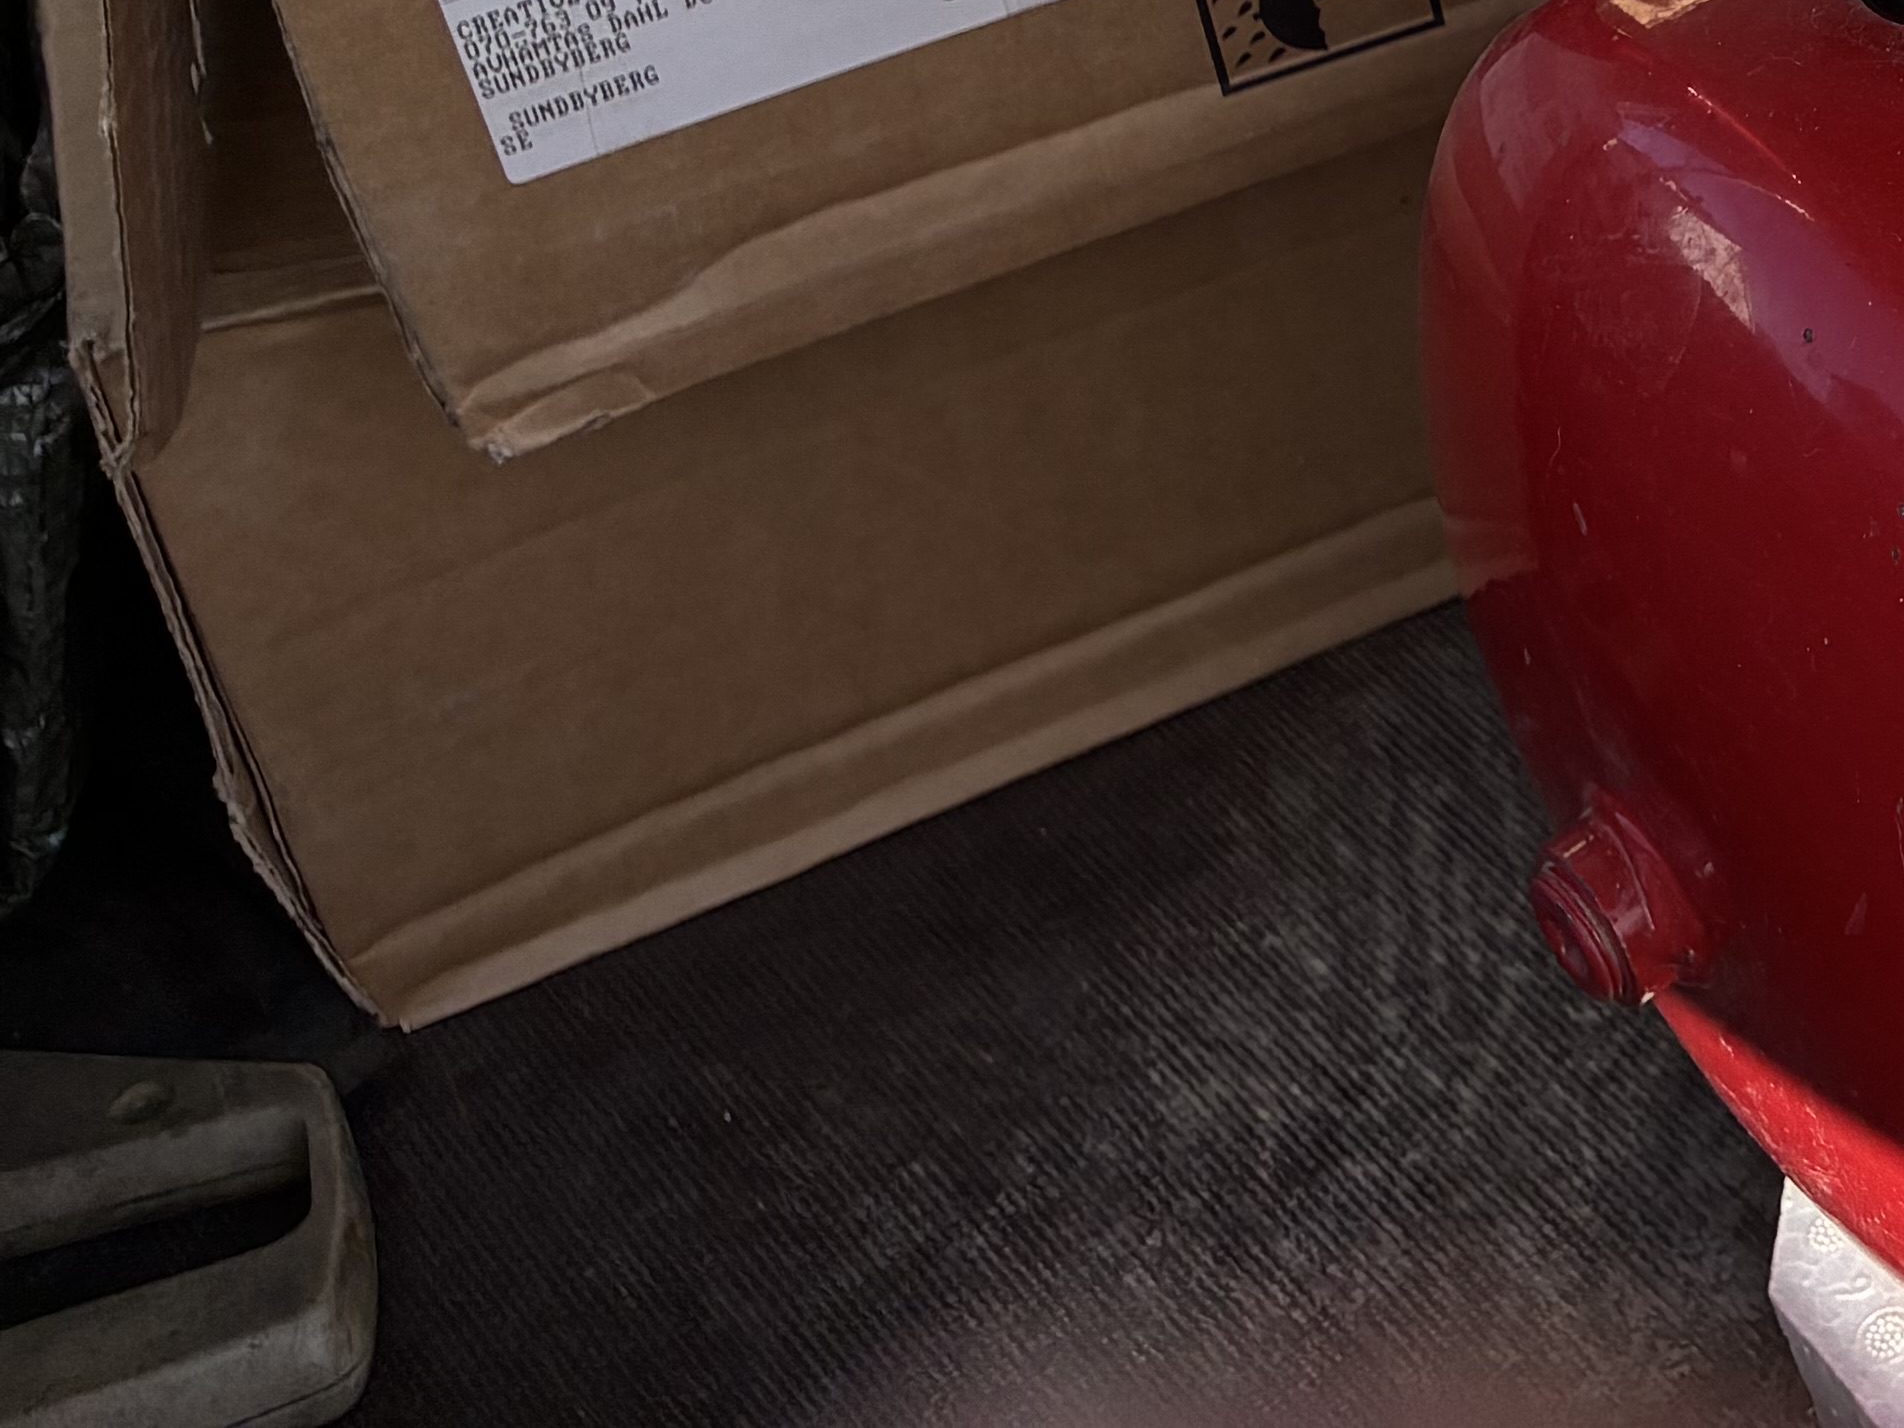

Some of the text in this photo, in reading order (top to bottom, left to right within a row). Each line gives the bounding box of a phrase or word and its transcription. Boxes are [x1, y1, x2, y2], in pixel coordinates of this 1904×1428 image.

[609, 0, 668, 34] DAHL
[477, 32, 631, 100] SUNDBYBERG
[508, 65, 660, 130] SUNDBYBERG
[500, 127, 533, 156] SE
